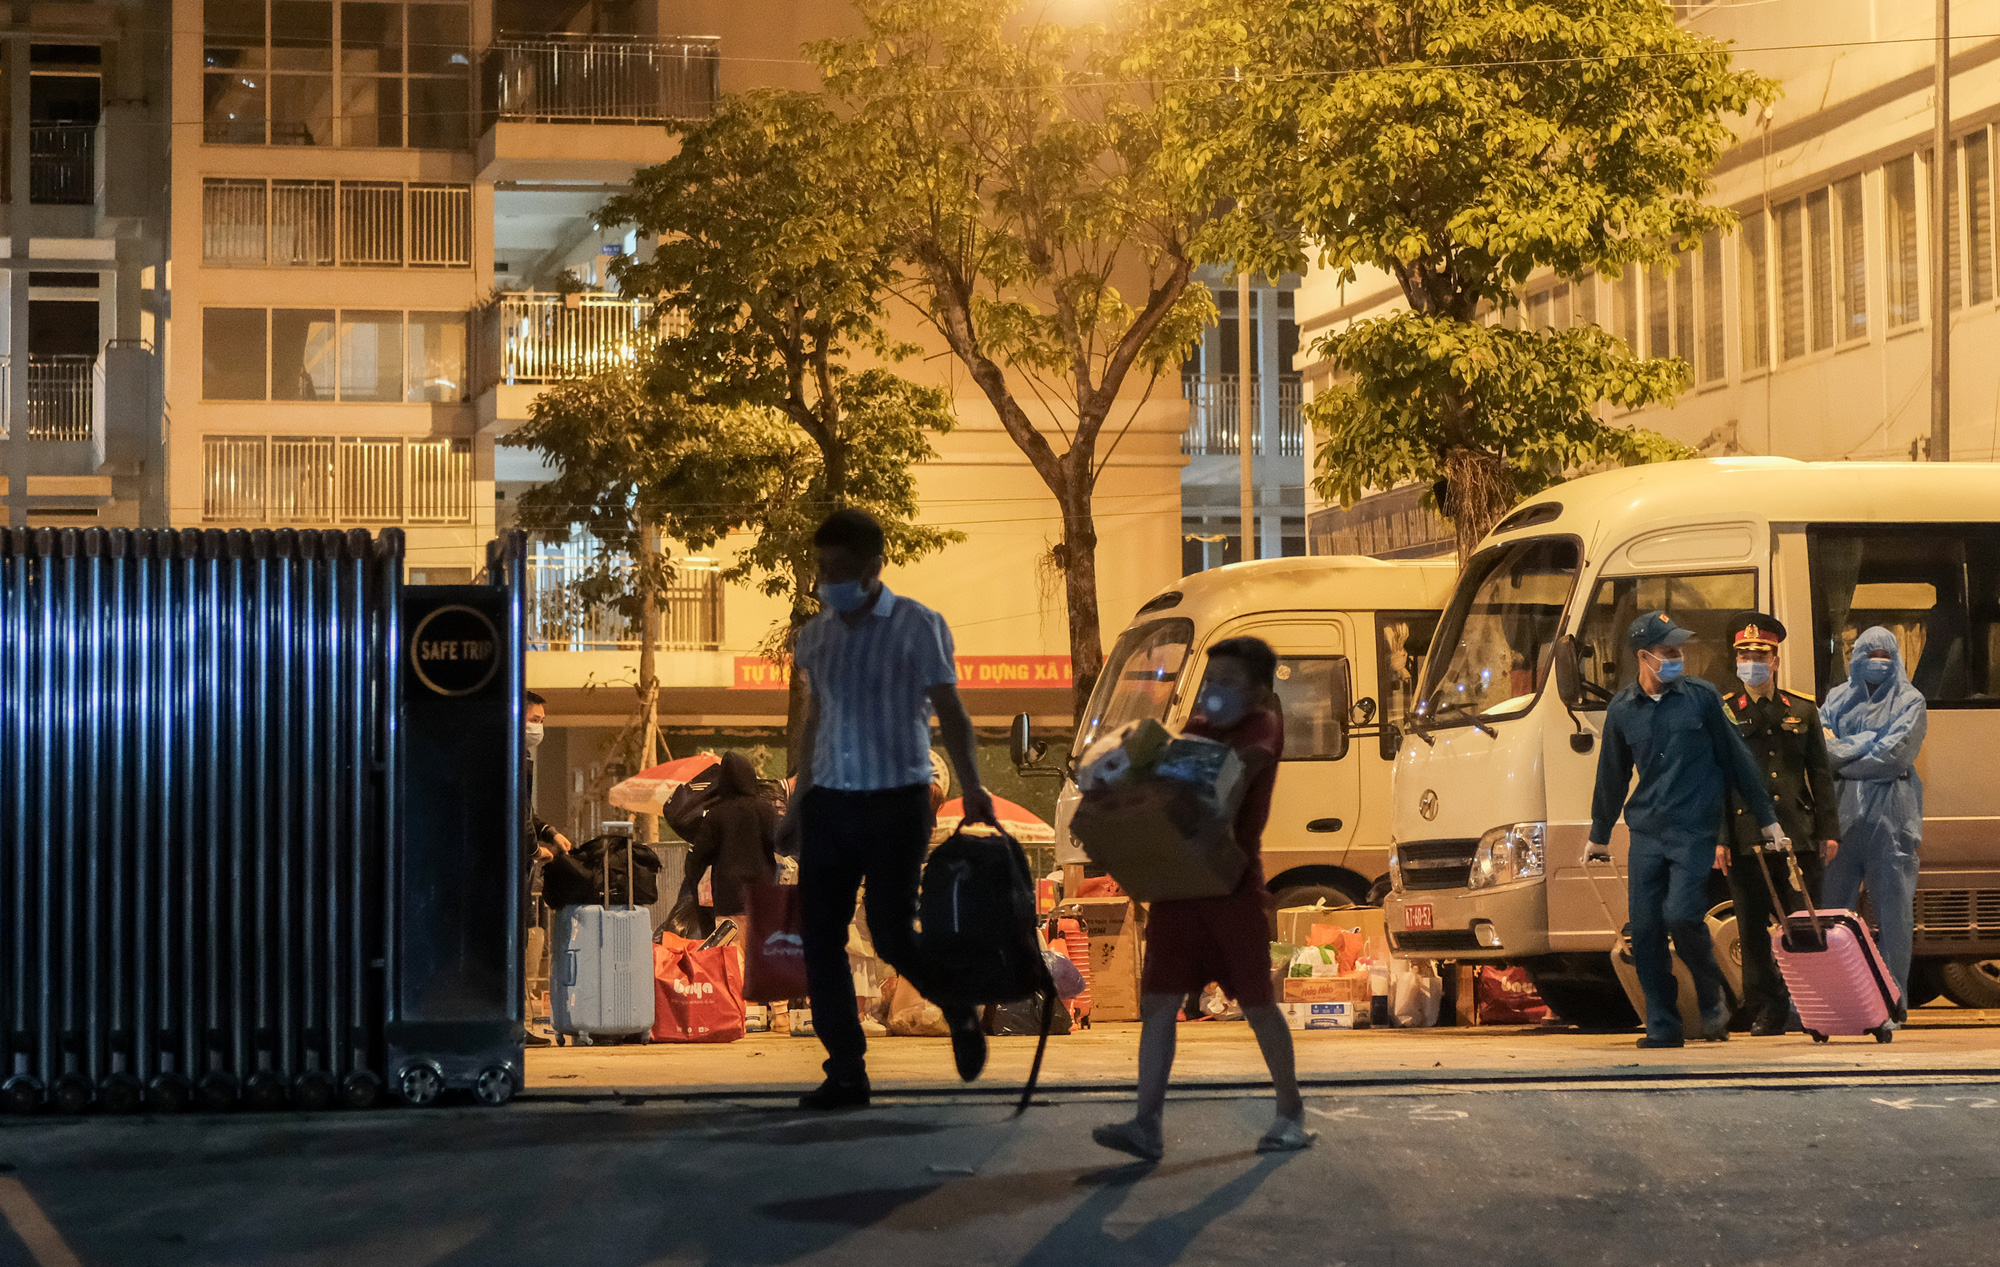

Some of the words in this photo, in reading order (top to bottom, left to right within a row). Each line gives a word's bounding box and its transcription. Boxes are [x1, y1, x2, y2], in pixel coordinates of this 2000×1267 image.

[421, 640, 458, 660] SAFE
[741, 664, 767, 685] TỰ
[979, 662, 1029, 684] DỰNG
[1035, 661, 1060, 680] XÃ
